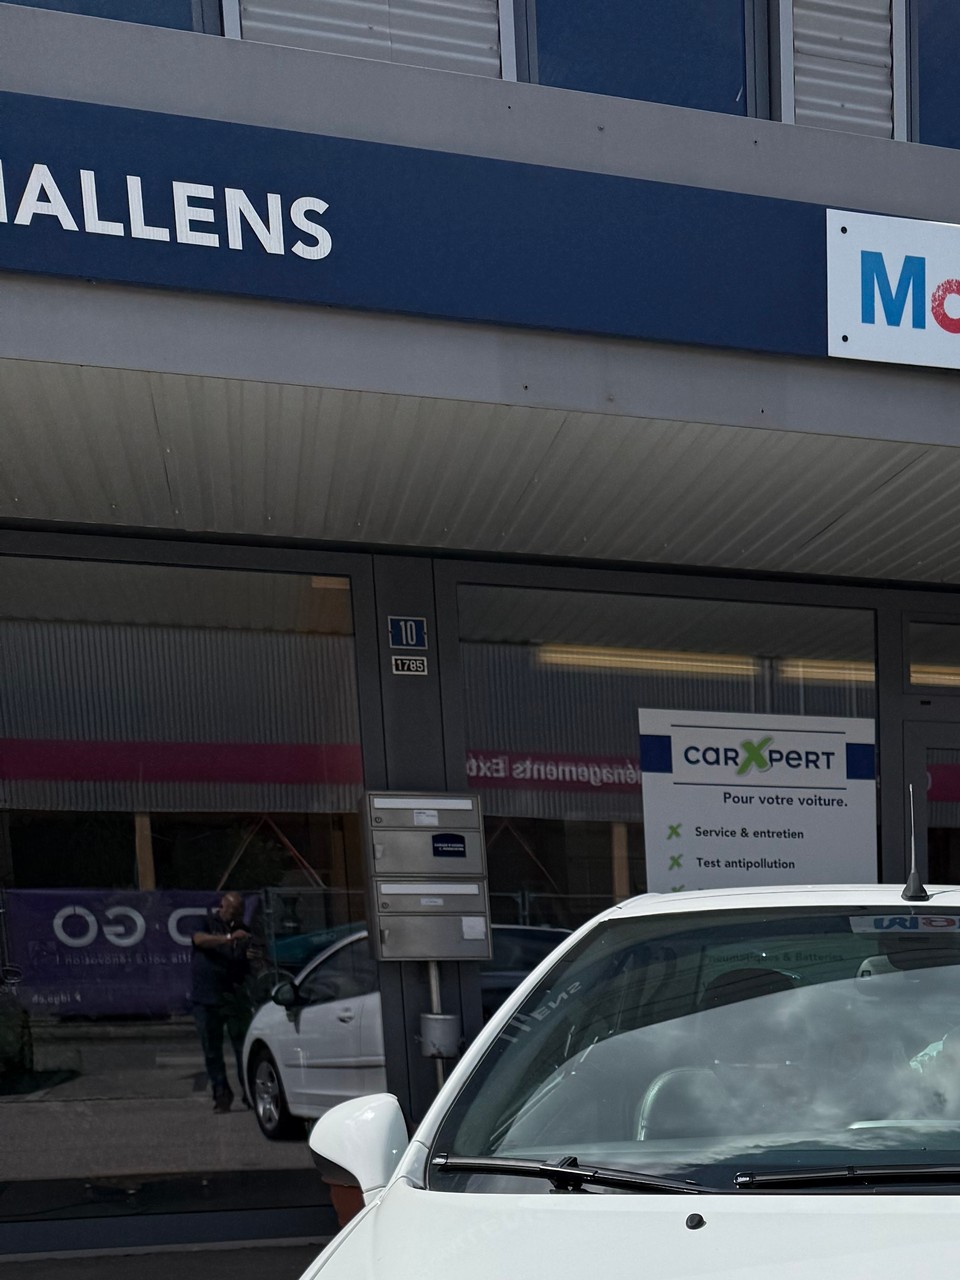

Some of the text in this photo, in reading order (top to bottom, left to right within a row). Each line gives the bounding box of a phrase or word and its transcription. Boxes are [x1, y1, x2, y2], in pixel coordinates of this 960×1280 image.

[399, 620, 417, 645] 10
[396, 659, 424, 672] 1785
[723, 791, 848, 808] Pour votre voiture.
[695, 826, 804, 840] Service & entretien
[696, 857, 796, 872] Test antipollution
